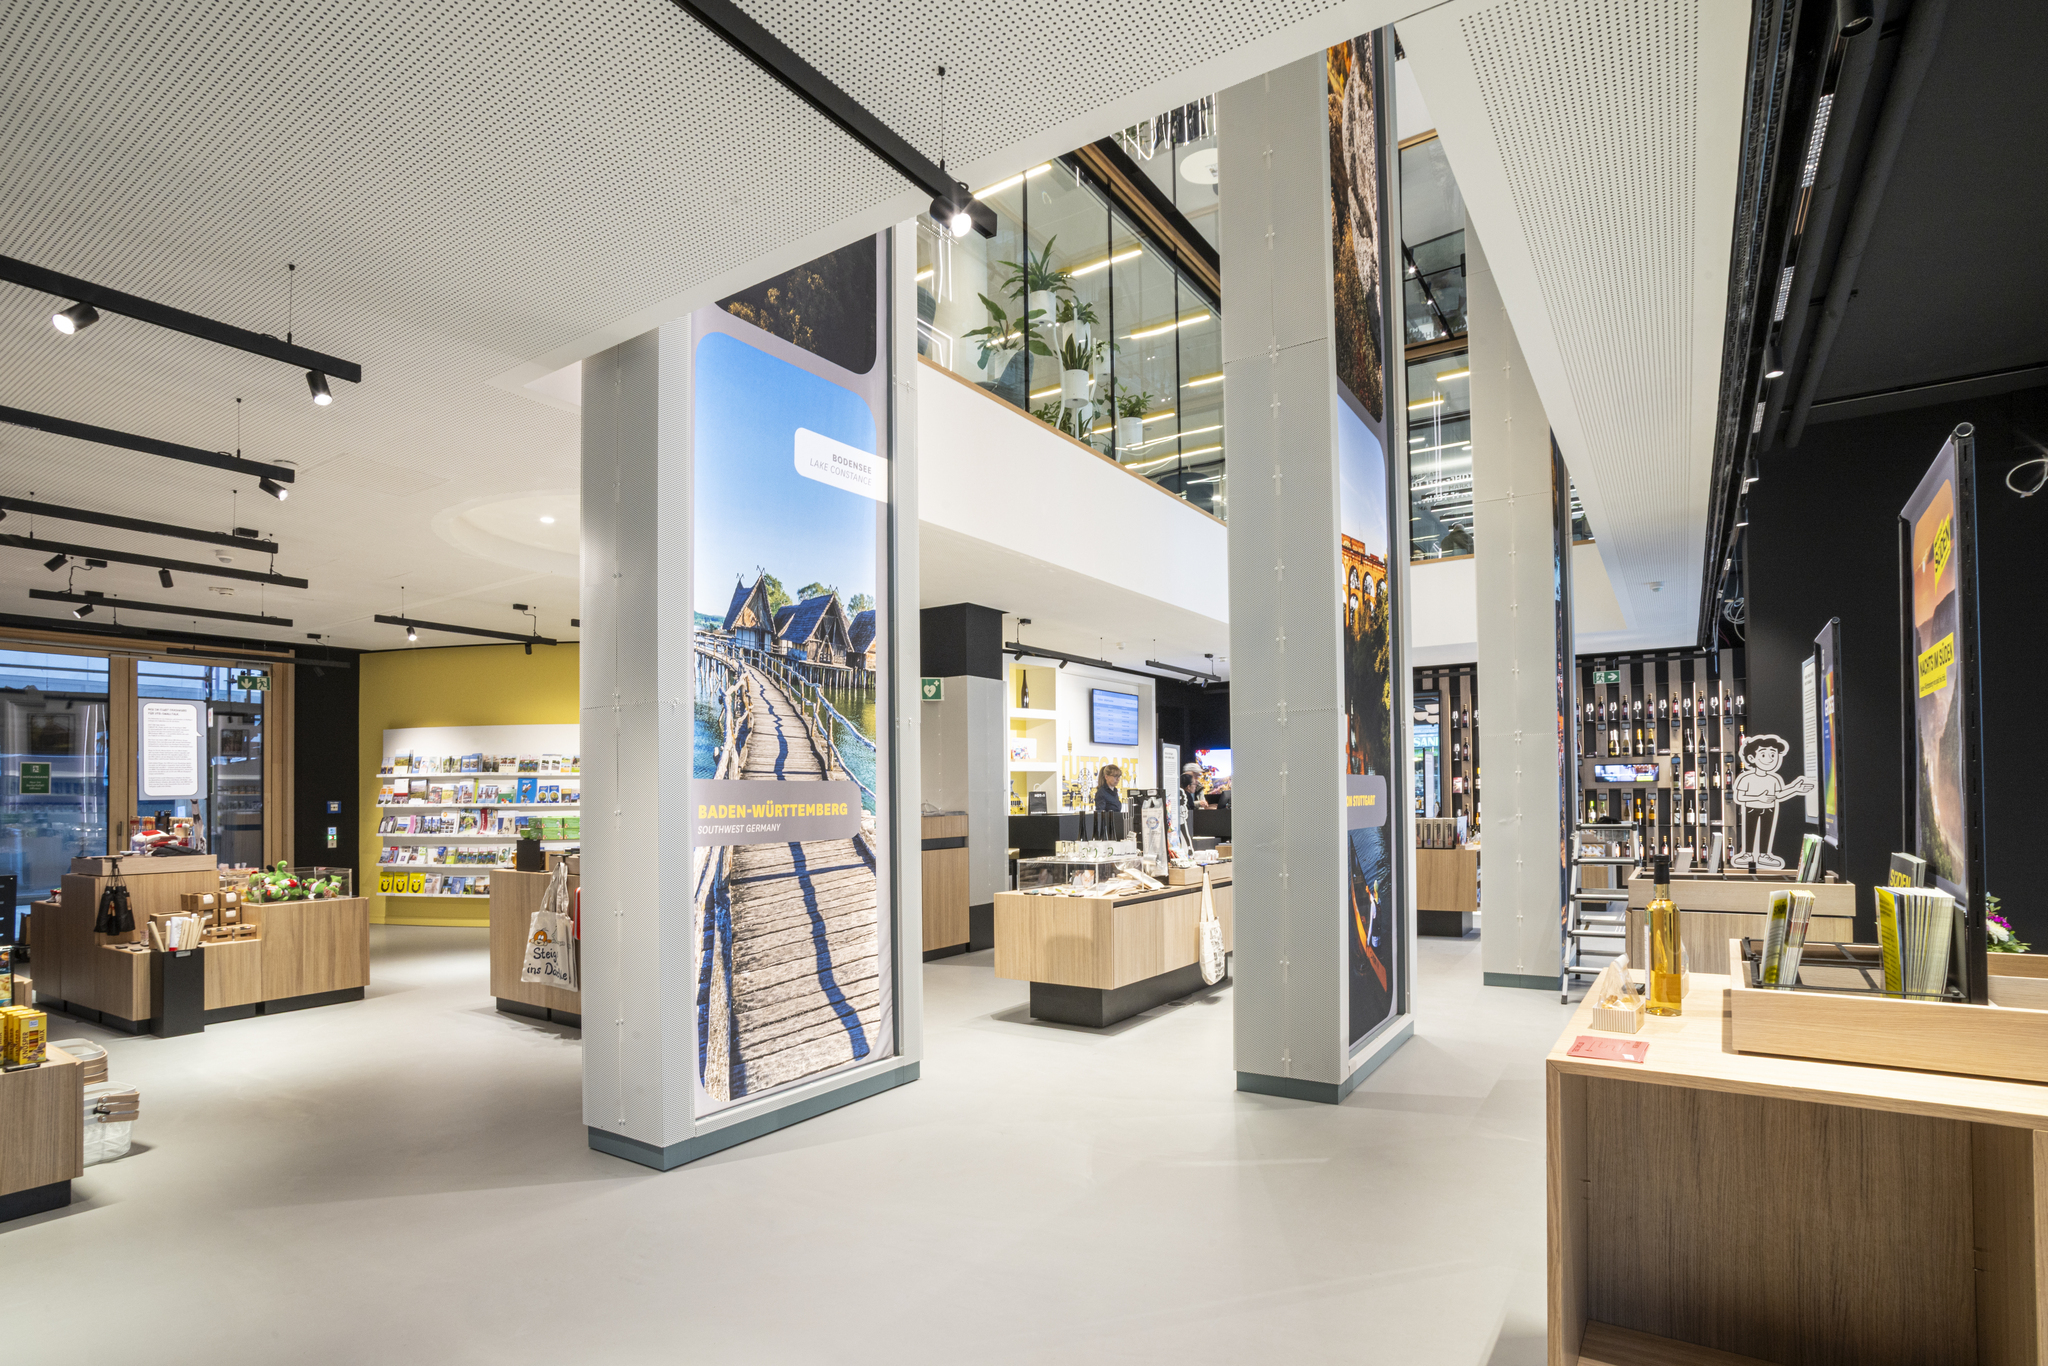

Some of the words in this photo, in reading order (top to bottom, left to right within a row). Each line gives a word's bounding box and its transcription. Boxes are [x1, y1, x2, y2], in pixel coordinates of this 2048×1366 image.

[810, 458, 828, 472] LAKE
[830, 465, 872, 486] CONSTANCE
[833, 454, 871, 474] BODENSEE
[1939, 641, 1953, 667] SÜDEN
[698, 800, 848, 819] BADEN-WÜRTTEMBERG
[1353, 795, 1375, 807] STUTTGART
[697, 824, 744, 835] SOUTHWEST
[745, 823, 781, 833] GERMANY
[527, 963, 541, 974] ins
